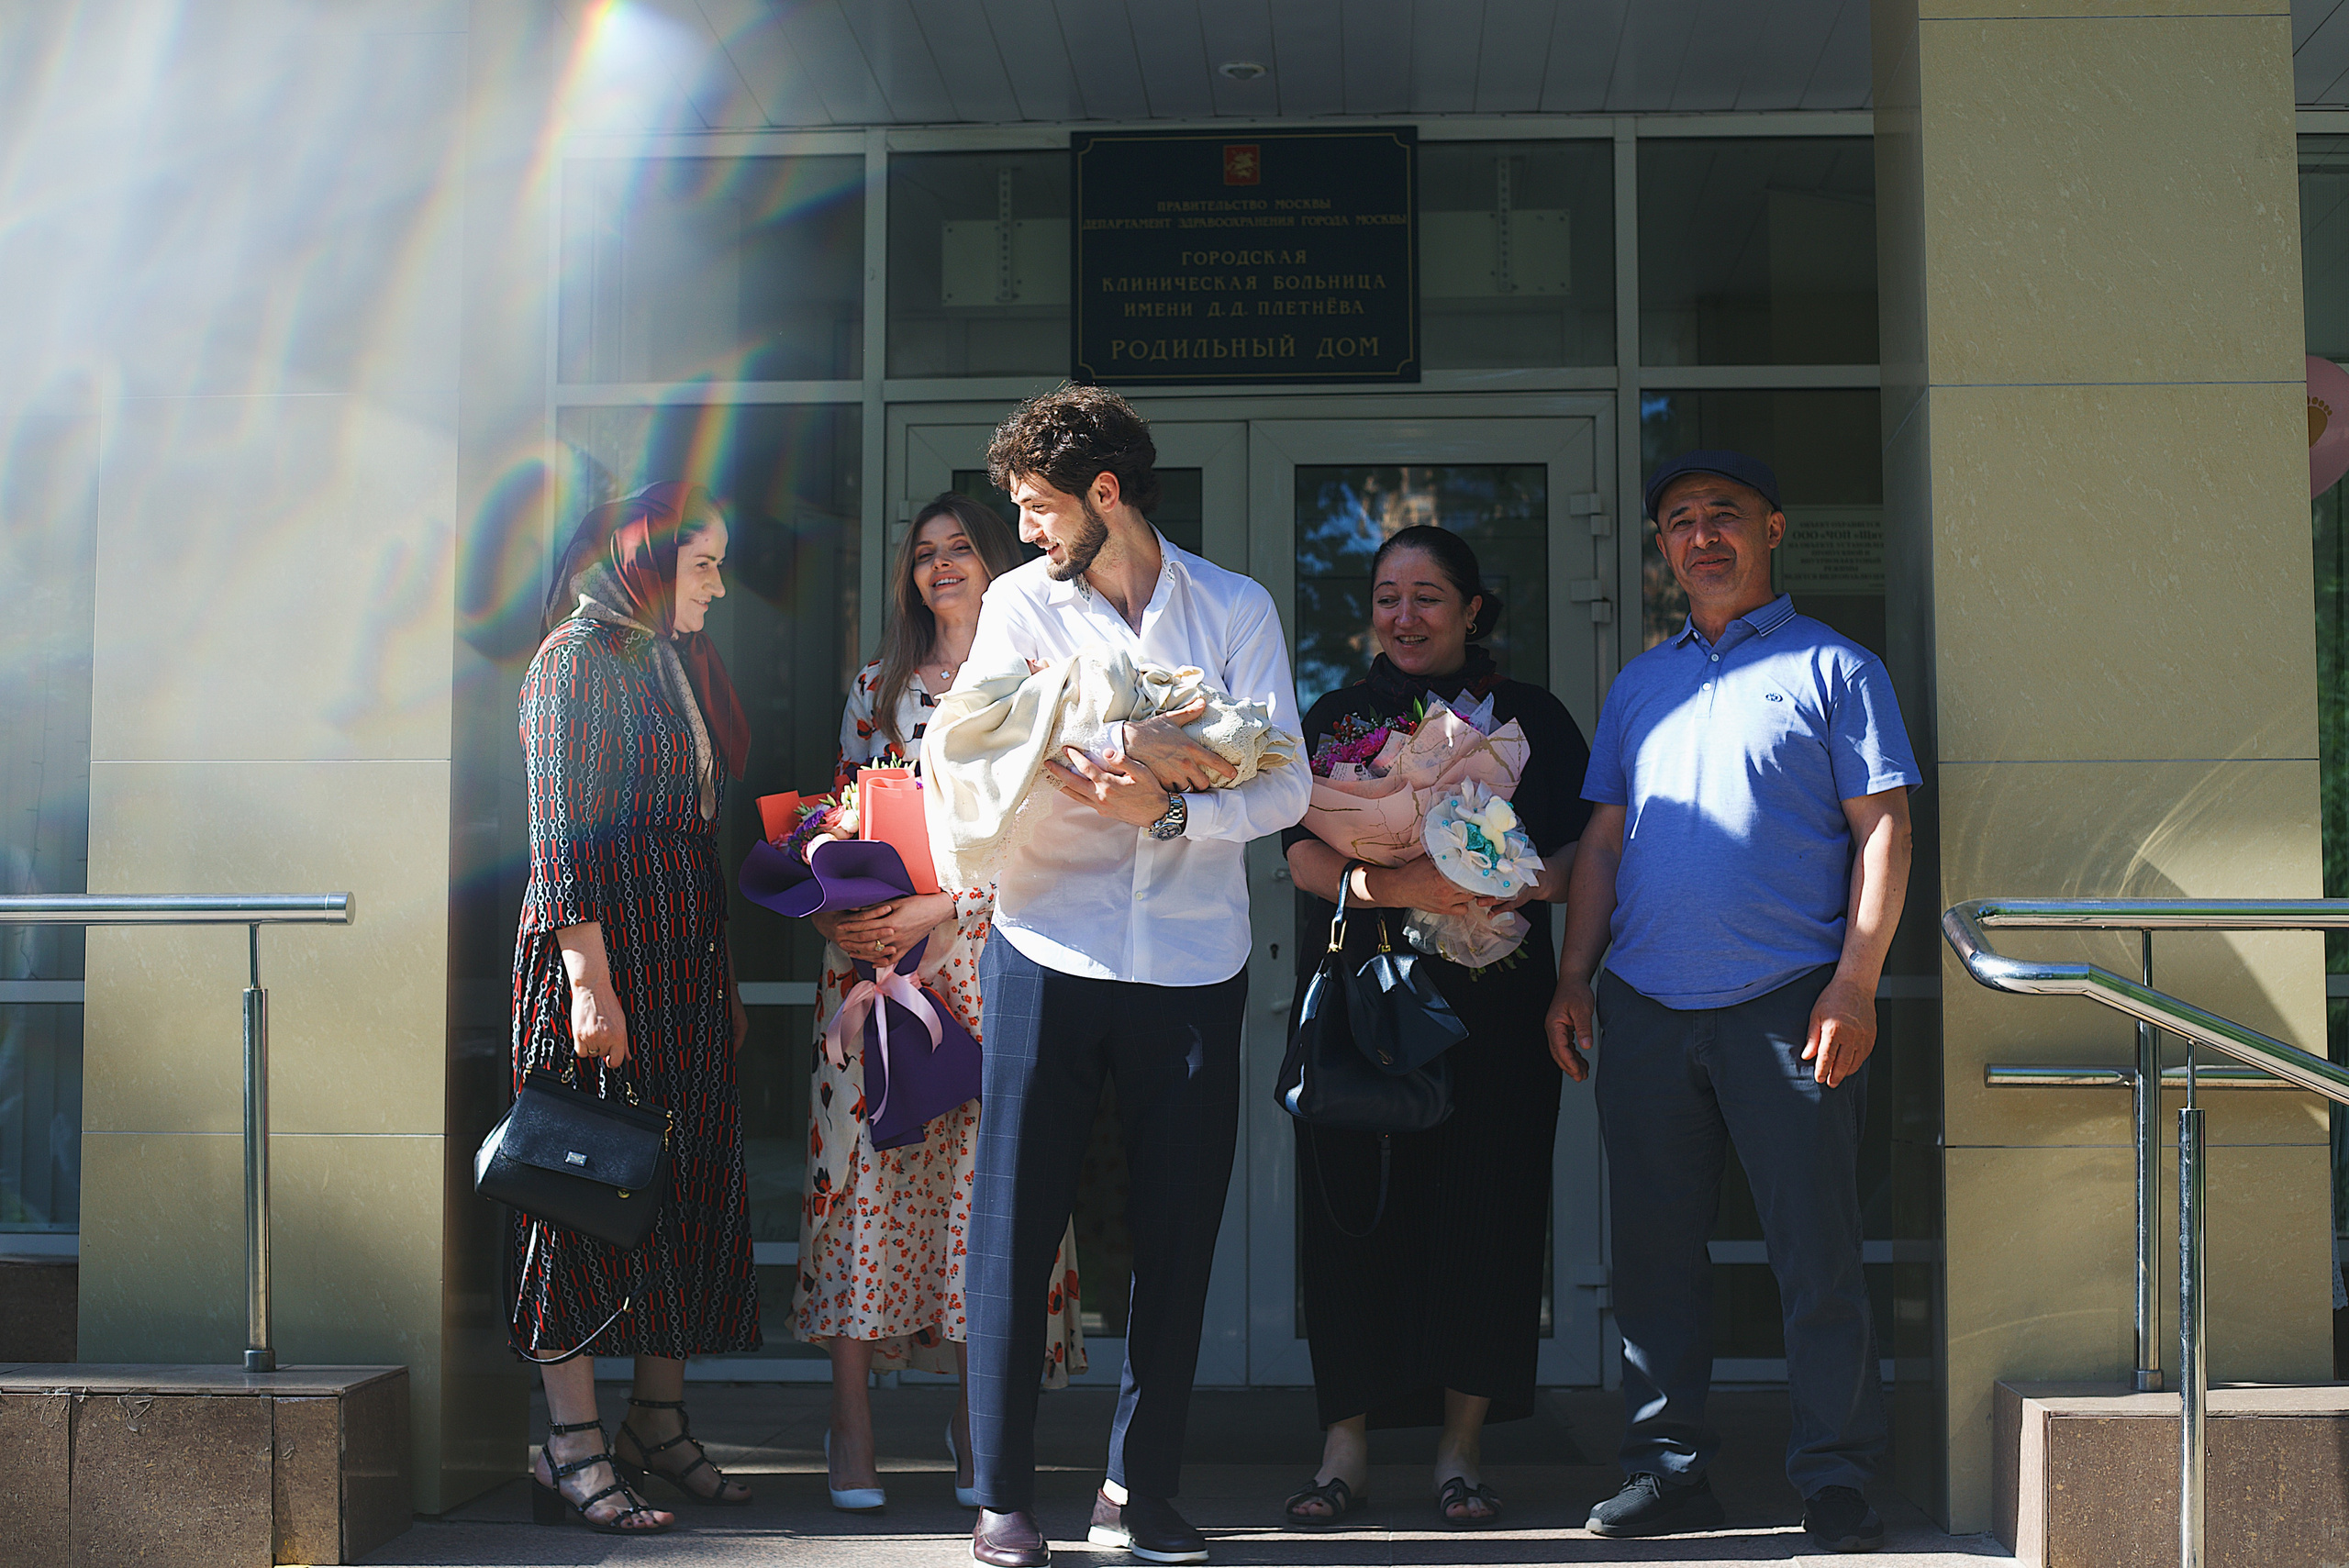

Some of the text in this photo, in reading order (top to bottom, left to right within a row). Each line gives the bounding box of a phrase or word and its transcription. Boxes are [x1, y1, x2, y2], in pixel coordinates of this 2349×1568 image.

[1157, 198, 1331, 212] ПРАВИТЕЛЬСТВО МОСКВЫ
[1082, 214, 1408, 230] ДЕПАРТАМЕНТ ЗДРАВООХРАНЕНИЯ ГОРОДА МОСКВЫ
[1181, 249, 1308, 267] ГОРОДСКАЯ
[1102, 274, 1386, 293] КЛИНИЧЕСКАЯ БОЛЬНИЦА
[1123, 302, 1193, 317] ИМЕНИ
[1257, 296, 1365, 316] ПЛЕТНЁВА
[1111, 334, 1379, 361] РОДИЛЬНЫЙ ДОМ
